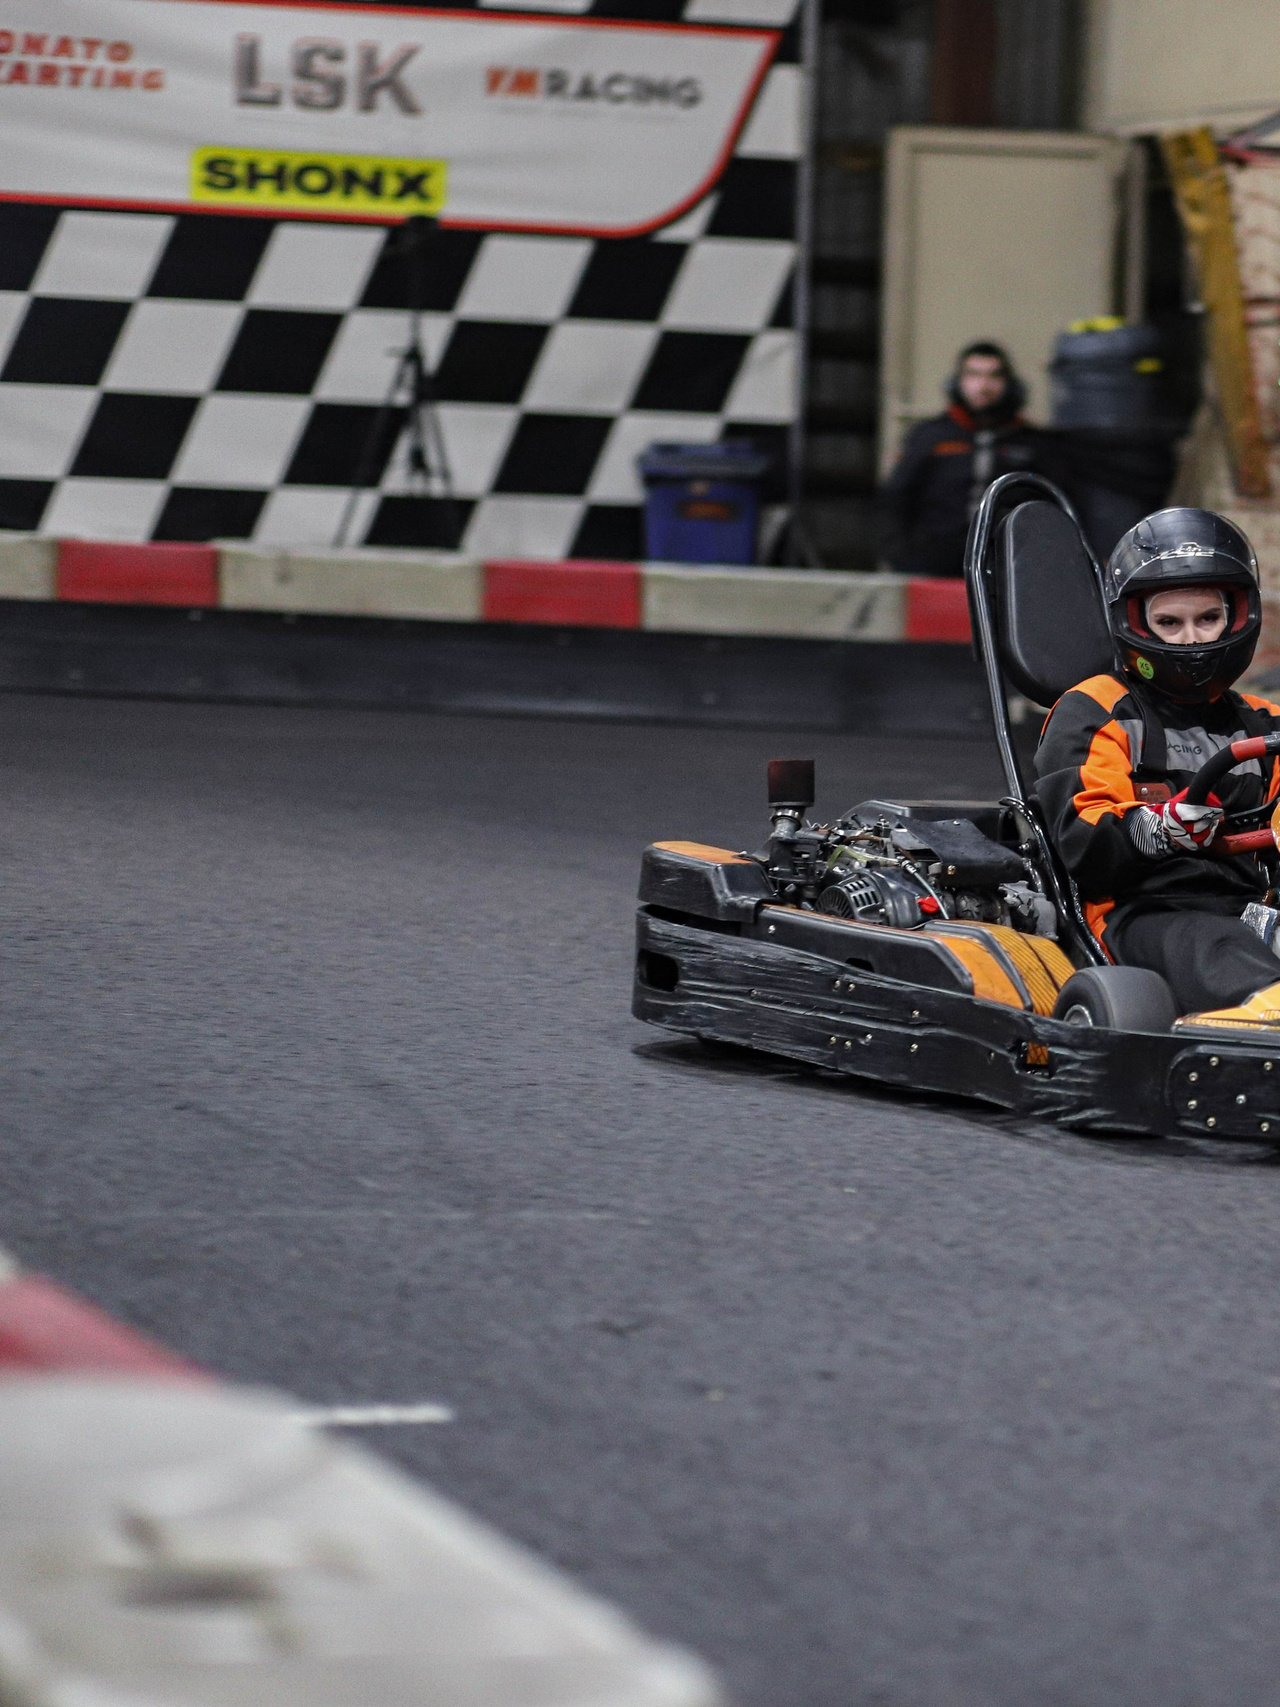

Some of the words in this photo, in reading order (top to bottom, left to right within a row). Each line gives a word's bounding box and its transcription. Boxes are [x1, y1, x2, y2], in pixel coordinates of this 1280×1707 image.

[0, 61, 166, 91] ARTING
[234, 32, 422, 116] LSK
[203, 158, 431, 201] SHONX
[1167, 743, 1202, 755] ACING
